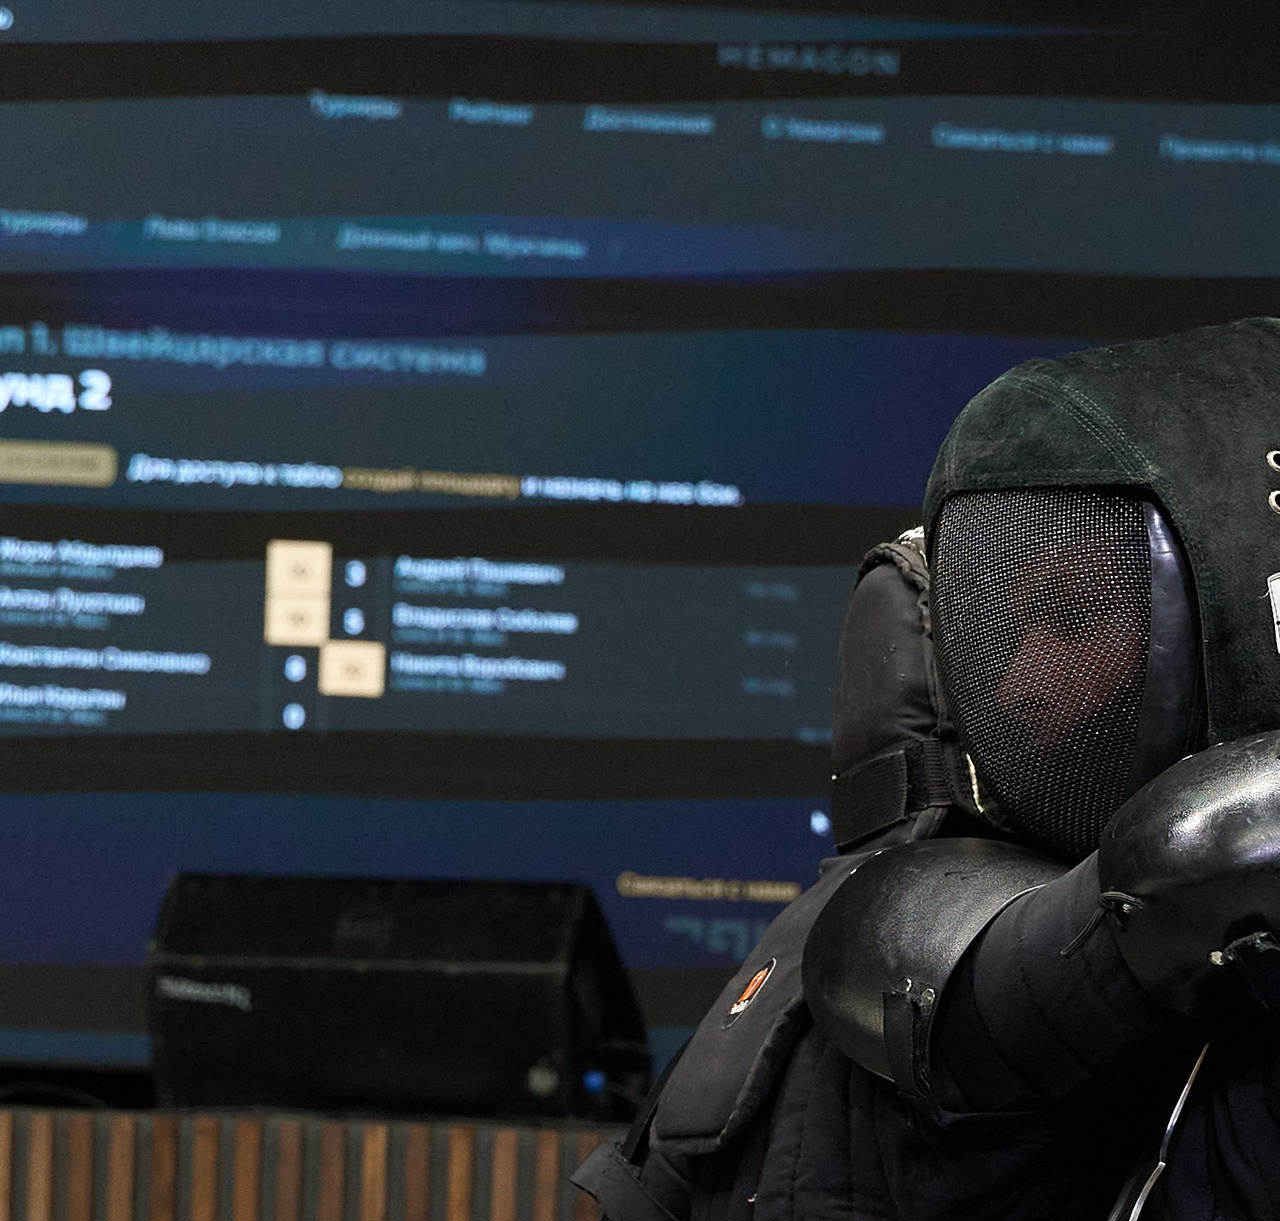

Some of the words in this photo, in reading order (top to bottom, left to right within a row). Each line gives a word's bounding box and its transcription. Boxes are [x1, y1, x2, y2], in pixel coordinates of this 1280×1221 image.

[63, 323, 325, 370] Швейцарская
[329, 341, 487, 376] система
[78, 369, 112, 411] 2
